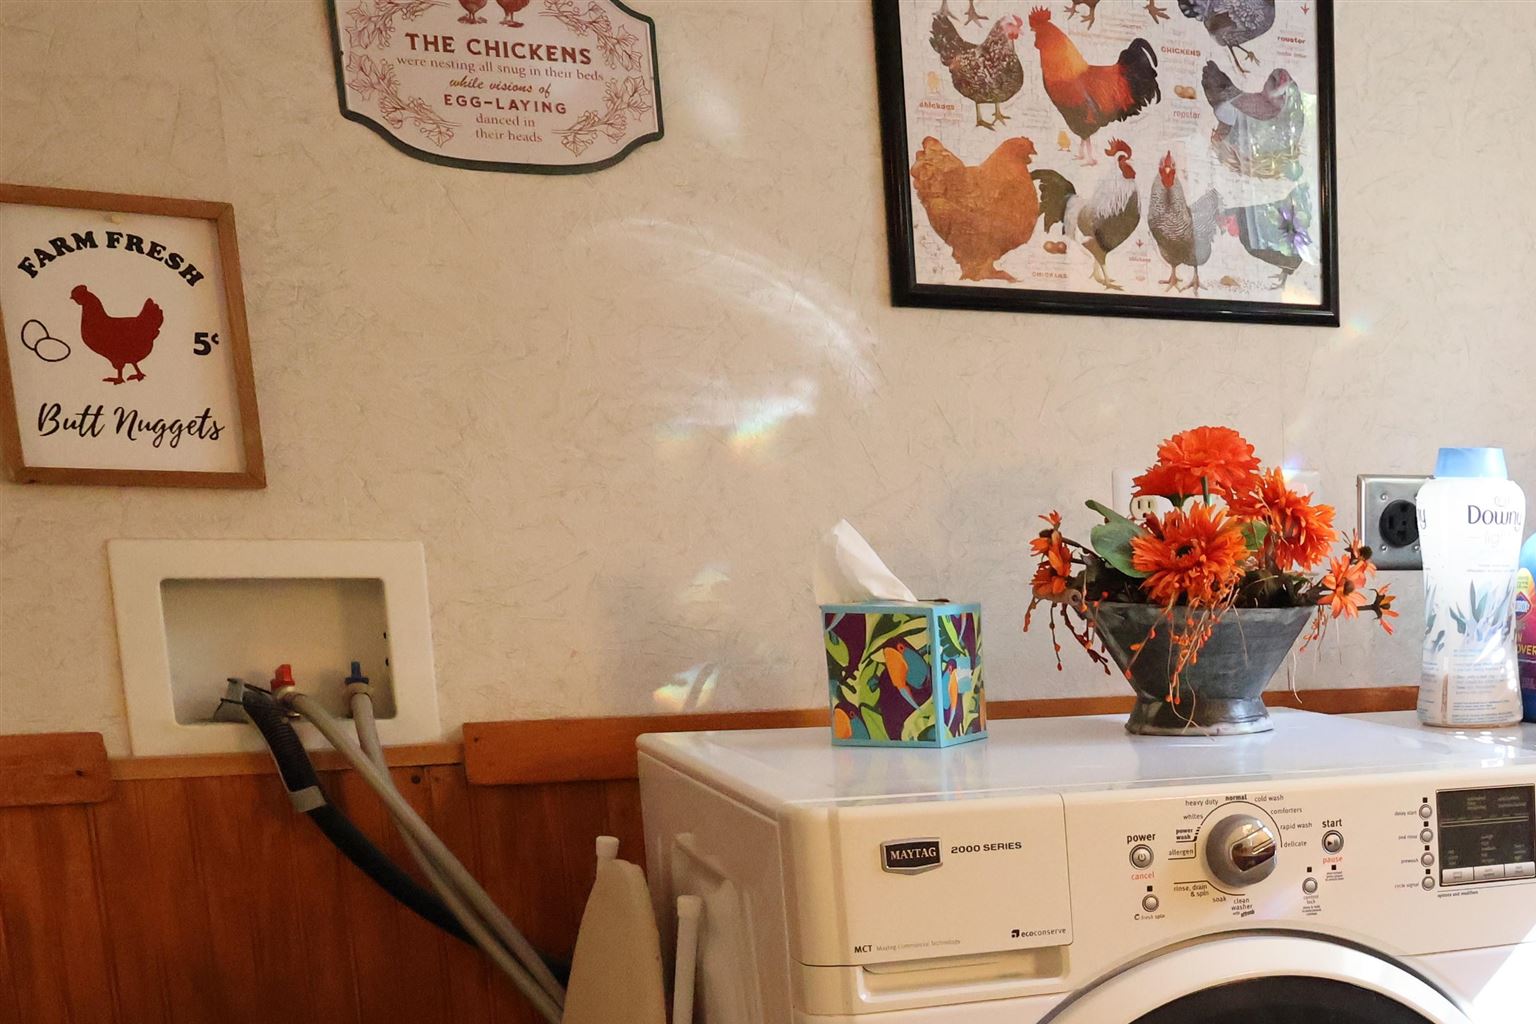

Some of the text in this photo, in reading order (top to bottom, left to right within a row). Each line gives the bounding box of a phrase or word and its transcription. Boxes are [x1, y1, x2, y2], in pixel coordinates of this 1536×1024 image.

[405, 33, 592, 65] THE CHICKENS
[396, 56, 427, 66] were
[430, 58, 476, 72] nesting
[479, 61, 493, 72] all
[497, 65, 526, 78] snug
[530, 65, 541, 77] in
[545, 67, 573, 80] their
[450, 75, 551, 98] while visions of
[444, 93, 567, 115] EGG-LAYING
[476, 113, 535, 126] danced in
[476, 128, 543, 142] their heads
[17, 230, 205, 287] FARM FRESH
[193, 332, 220, 356] 5¢
[37, 402, 225, 449] Butt Nuggets
[1467, 504, 1522, 530] Downy
[1270, 807, 1303, 815] comforters
[1280, 823, 1296, 831] rapid
[1321, 819, 1343, 828] start
[1126, 833, 1156, 845] power
[1283, 840, 1308, 848] delicate
[890, 841, 1022, 861] MAYTAG 2000 SERIES
[1168, 848, 1194, 856] allergen
[1322, 856, 1343, 865] pause
[1131, 871, 1155, 881] cancel
[1173, 885, 1191, 893] rinse,
[1196, 890, 1210, 898] spin
[1020, 927, 1067, 938] ecoconserve
[854, 944, 873, 954] MCT
